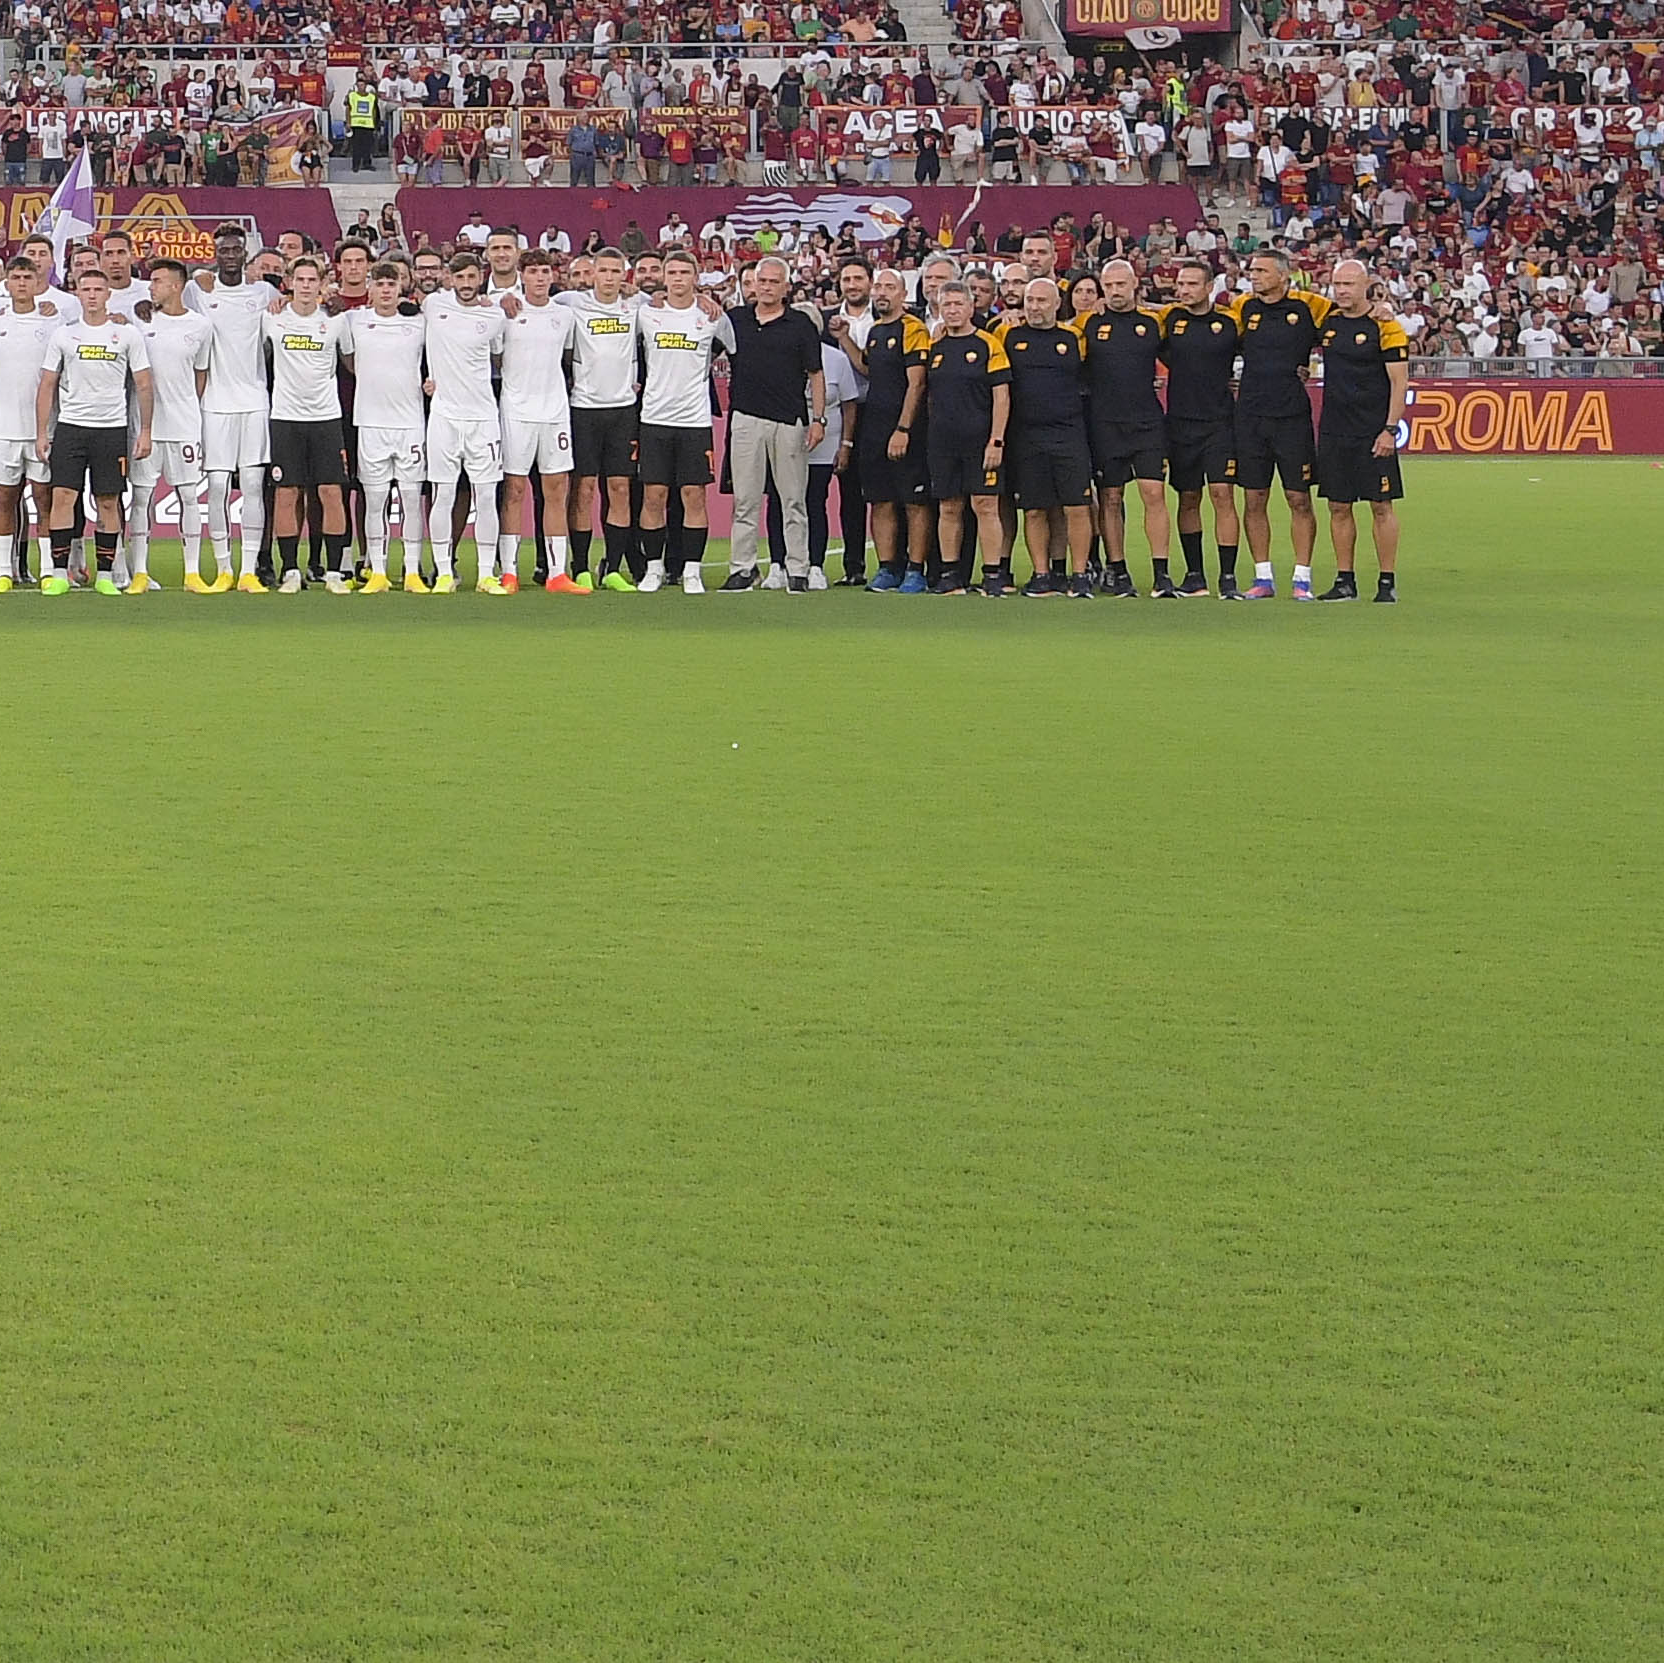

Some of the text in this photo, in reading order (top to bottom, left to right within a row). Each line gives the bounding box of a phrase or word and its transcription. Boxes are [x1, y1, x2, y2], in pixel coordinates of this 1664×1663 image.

[651, 107, 695, 116] ROMA
[128, 230, 214, 244] MAGLIA
[1408, 390, 1613, 451] ROMA
[558, 432, 568, 450] 6
